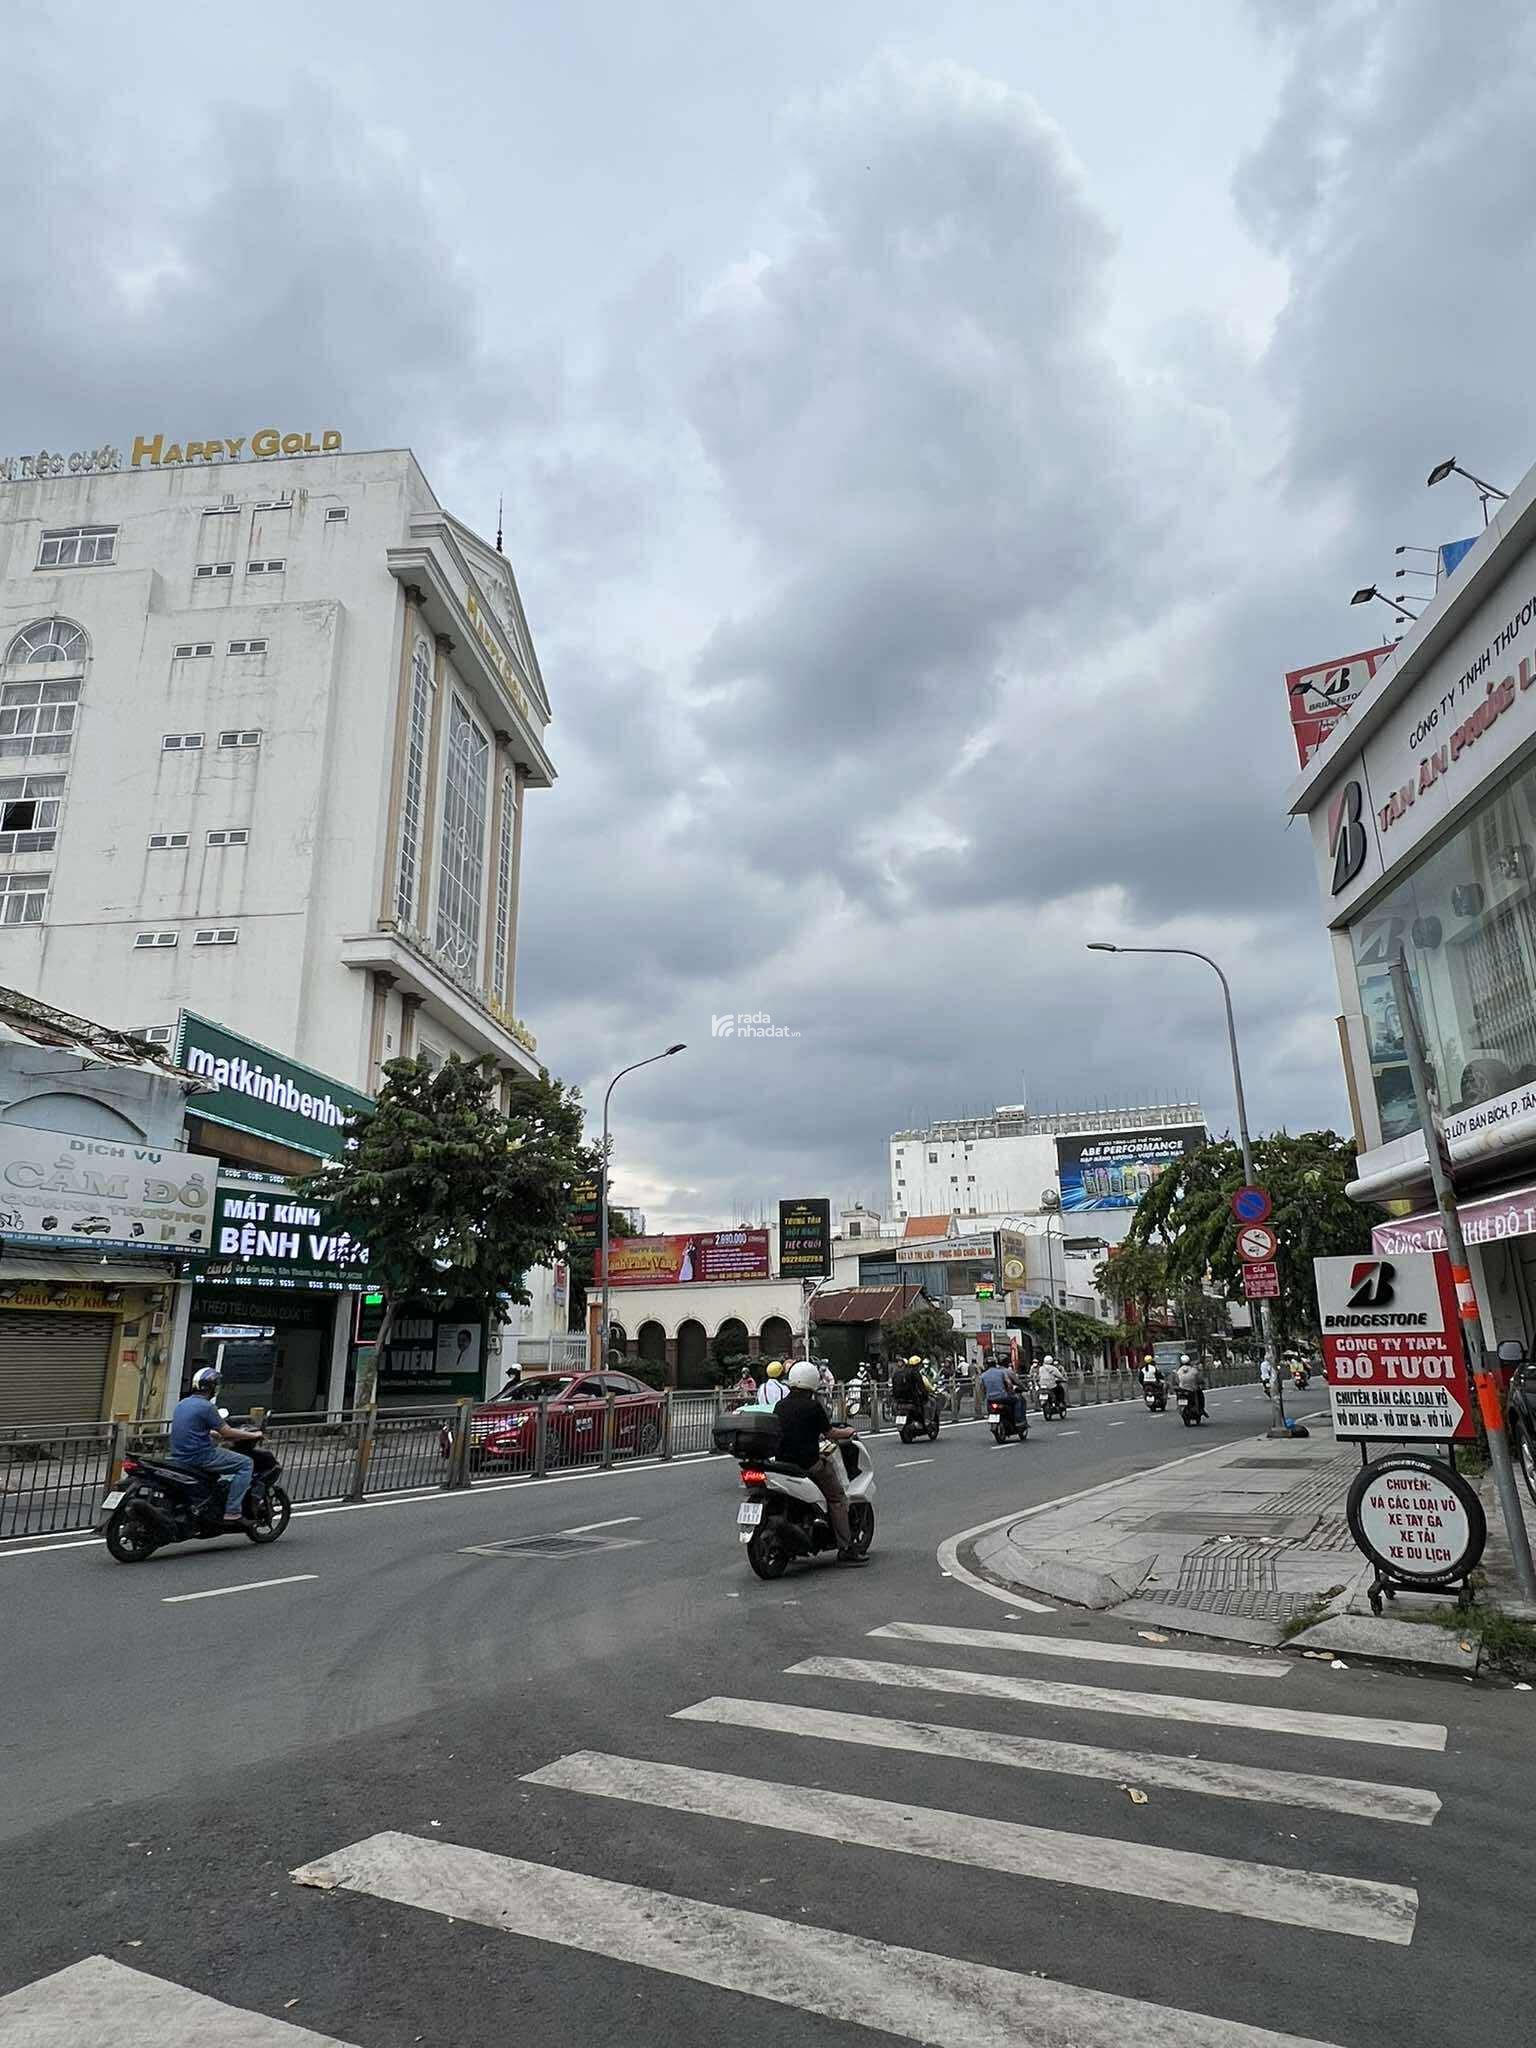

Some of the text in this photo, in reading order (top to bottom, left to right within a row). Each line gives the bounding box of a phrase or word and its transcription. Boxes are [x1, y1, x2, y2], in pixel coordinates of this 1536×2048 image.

[131, 434, 246, 466] HAPPY
[251, 429, 342, 457] GOLD
[1409, 597, 1536, 750] CÔNG TY TNHH THƯƠ
[1518, 649, 1536, 692] L
[1469, 1112, 1486, 1131] BÁN
[1511, 1101, 1520, 1116] P.
[70, 1140, 161, 1165] DỊCH VỤ
[1080, 1140, 1183, 1157] ABE PERFORMANCE
[224, 1194, 321, 1227] MẮT KÍNH
[1425, 1228, 1443, 1249] TY
[1495, 1206, 1520, 1238] ĐÔ
[219, 1222, 300, 1262] BỆNH
[1325, 1313, 1428, 1328] BRIDGESTONE
[1336, 1336, 1447, 1351] CÔNG TY TAPL
[1335, 1353, 1456, 1379] ĐÔ TƯƠI
[1336, 1388, 1448, 1406] CHUYÊN BÁN CÁC LOẠI VỎ
[1349, 1413, 1360, 1426] DU
[1395, 1413, 1409, 1427] TAY
[1410, 1414, 1421, 1427] GA
[1439, 1410, 1453, 1427] TẢI
[1386, 1478, 1431, 1491] CHUYÊN:
[1388, 1495, 1409, 1510] CÁC
[1414, 1498, 1438, 1513] LOẠI
[1441, 1495, 1456, 1512] VỎ
[1388, 1513, 1443, 1527] XE TAY GA
[1400, 1527, 1435, 1543] XE TẢI
[1389, 1546, 1451, 1563] XE DU LỊCH
